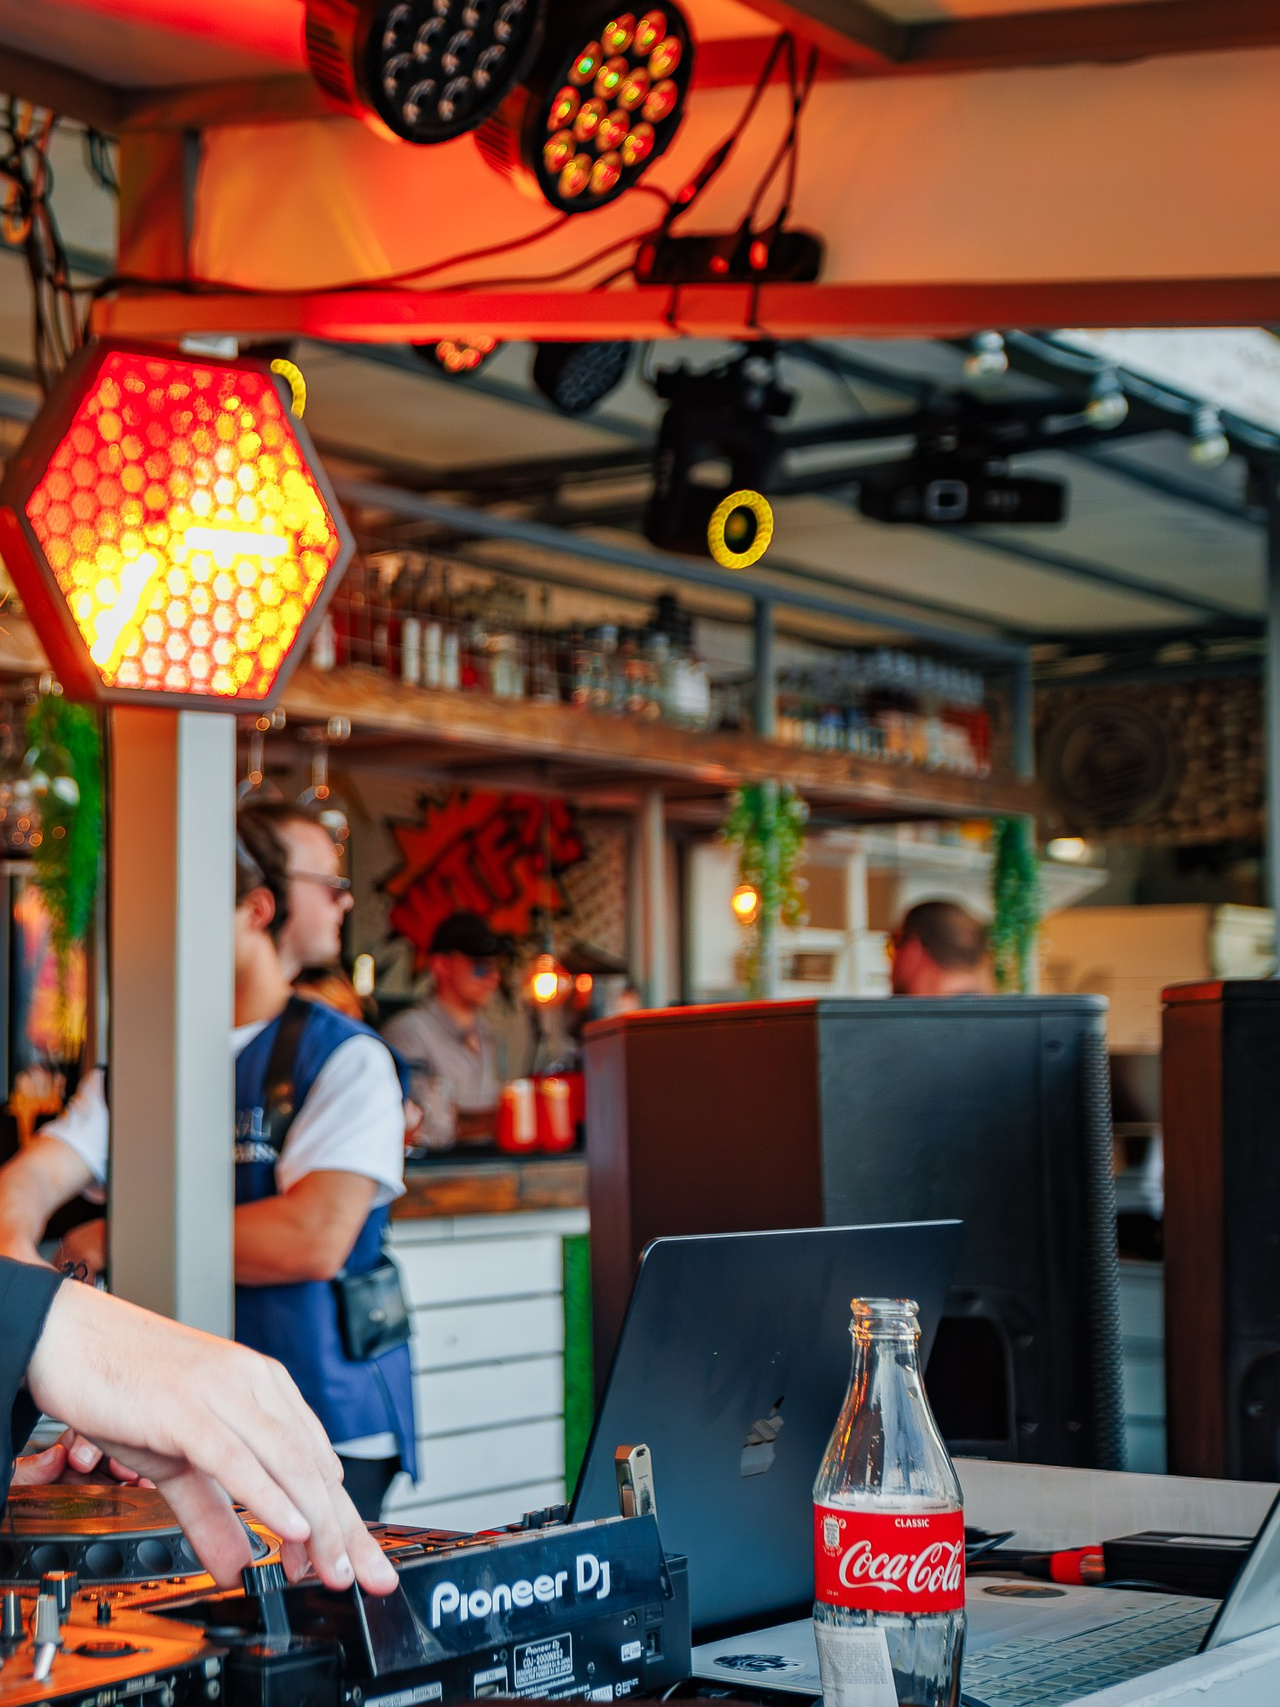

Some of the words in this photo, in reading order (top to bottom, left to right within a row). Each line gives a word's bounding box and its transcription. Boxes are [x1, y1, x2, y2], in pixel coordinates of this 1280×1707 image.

[894, 1517, 930, 1528] CLASSIC
[839, 1540, 963, 1593] Coca-Cola
[432, 1570, 568, 1628] Pioneer
[525, 1643, 552, 1657] Pioneer
